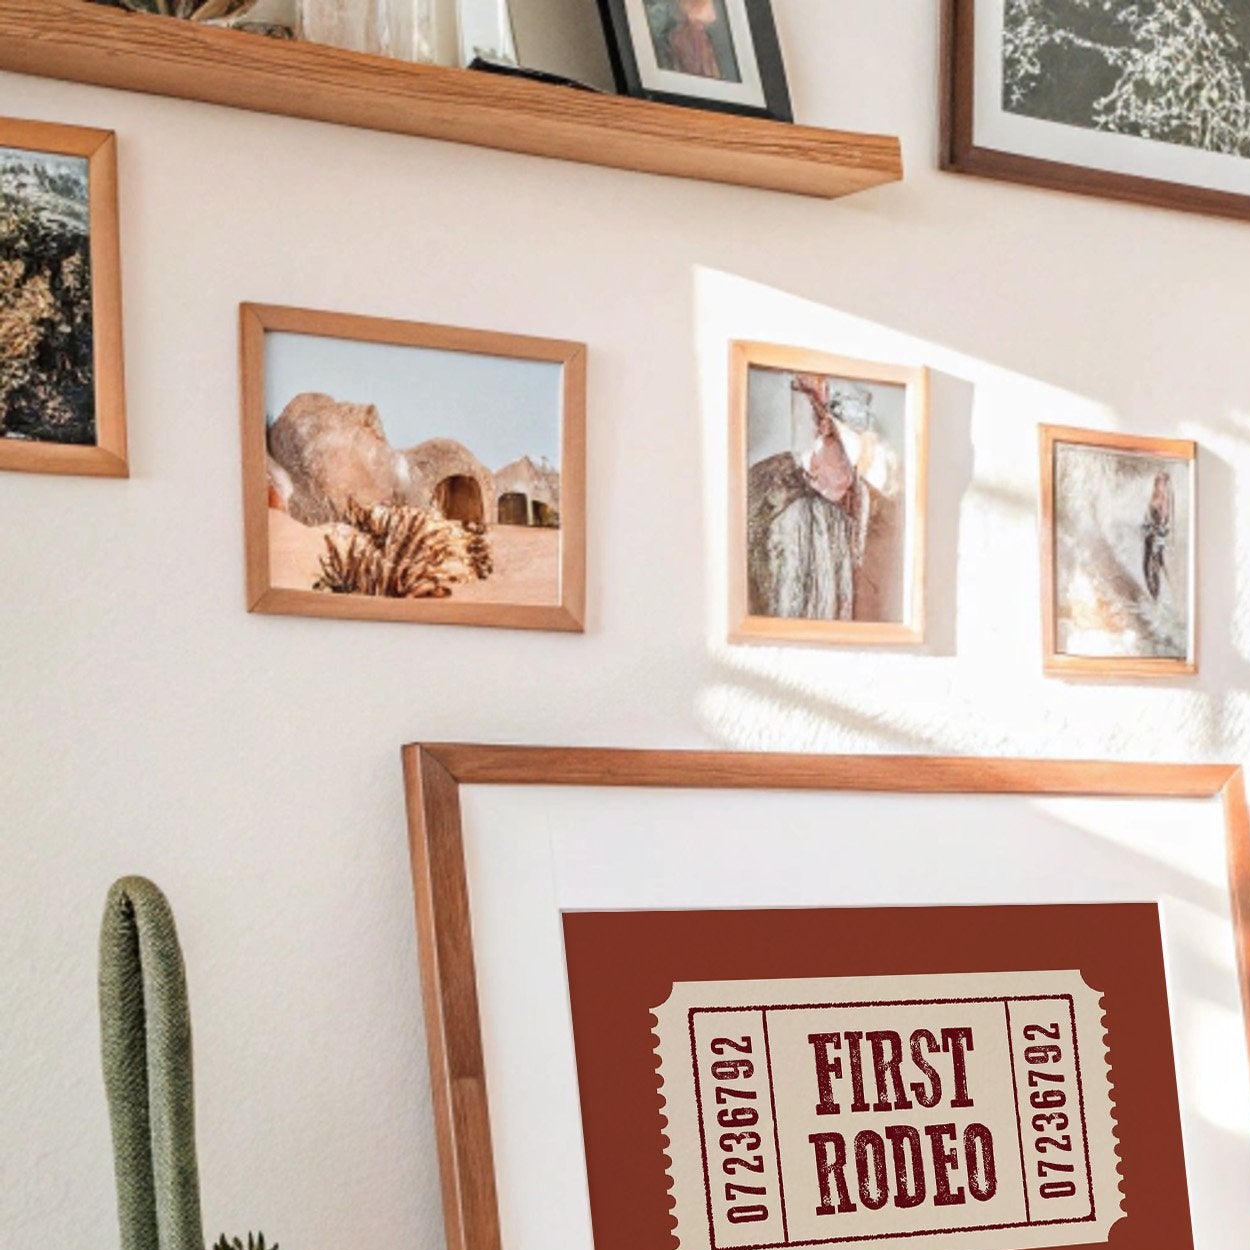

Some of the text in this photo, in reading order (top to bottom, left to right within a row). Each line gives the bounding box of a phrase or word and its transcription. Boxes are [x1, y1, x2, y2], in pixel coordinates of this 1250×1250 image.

[711, 1035, 769, 1224] 07236792
[808, 1027, 974, 1116] FIRST
[1023, 1022, 1076, 1199] 07236792
[809, 1122, 997, 1215] RODEO
